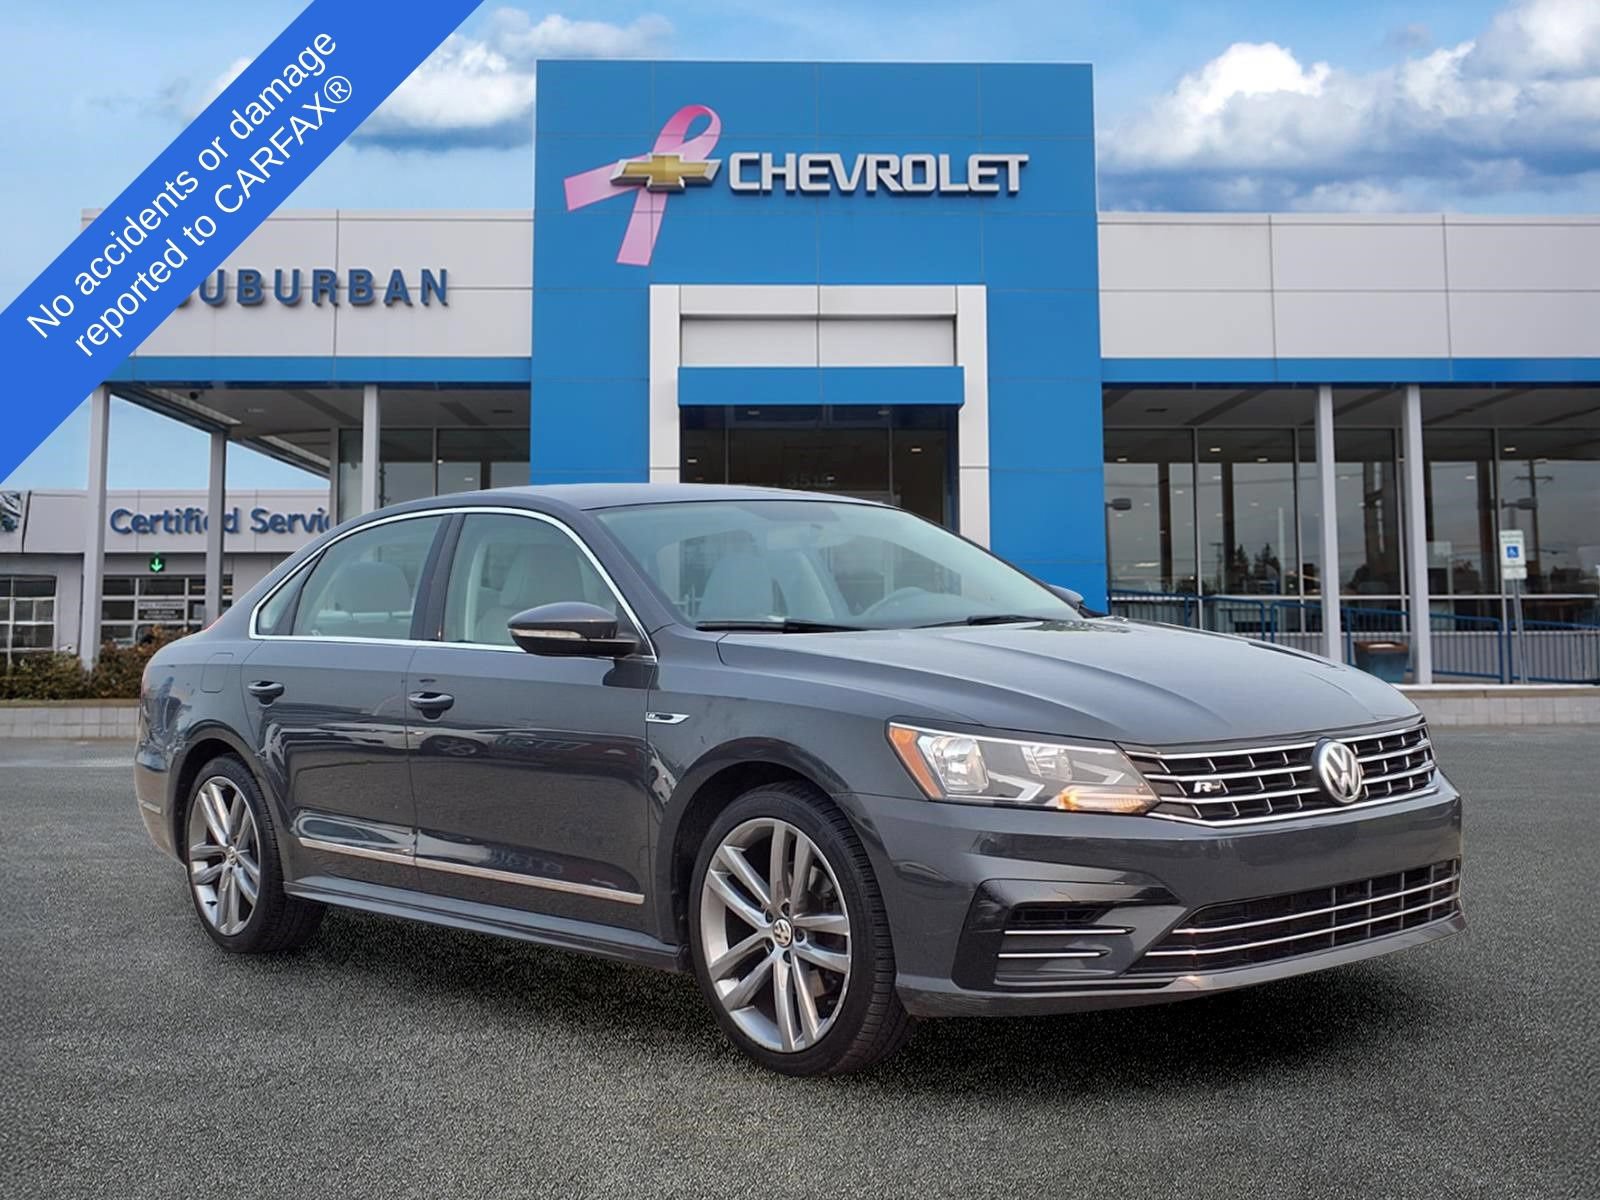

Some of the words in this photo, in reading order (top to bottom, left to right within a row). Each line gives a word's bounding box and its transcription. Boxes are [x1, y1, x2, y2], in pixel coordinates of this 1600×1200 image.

[729, 152, 1028, 191] CHEVROLET
[177, 269, 447, 306] UBURBAN
[110, 508, 240, 533] Certifid
